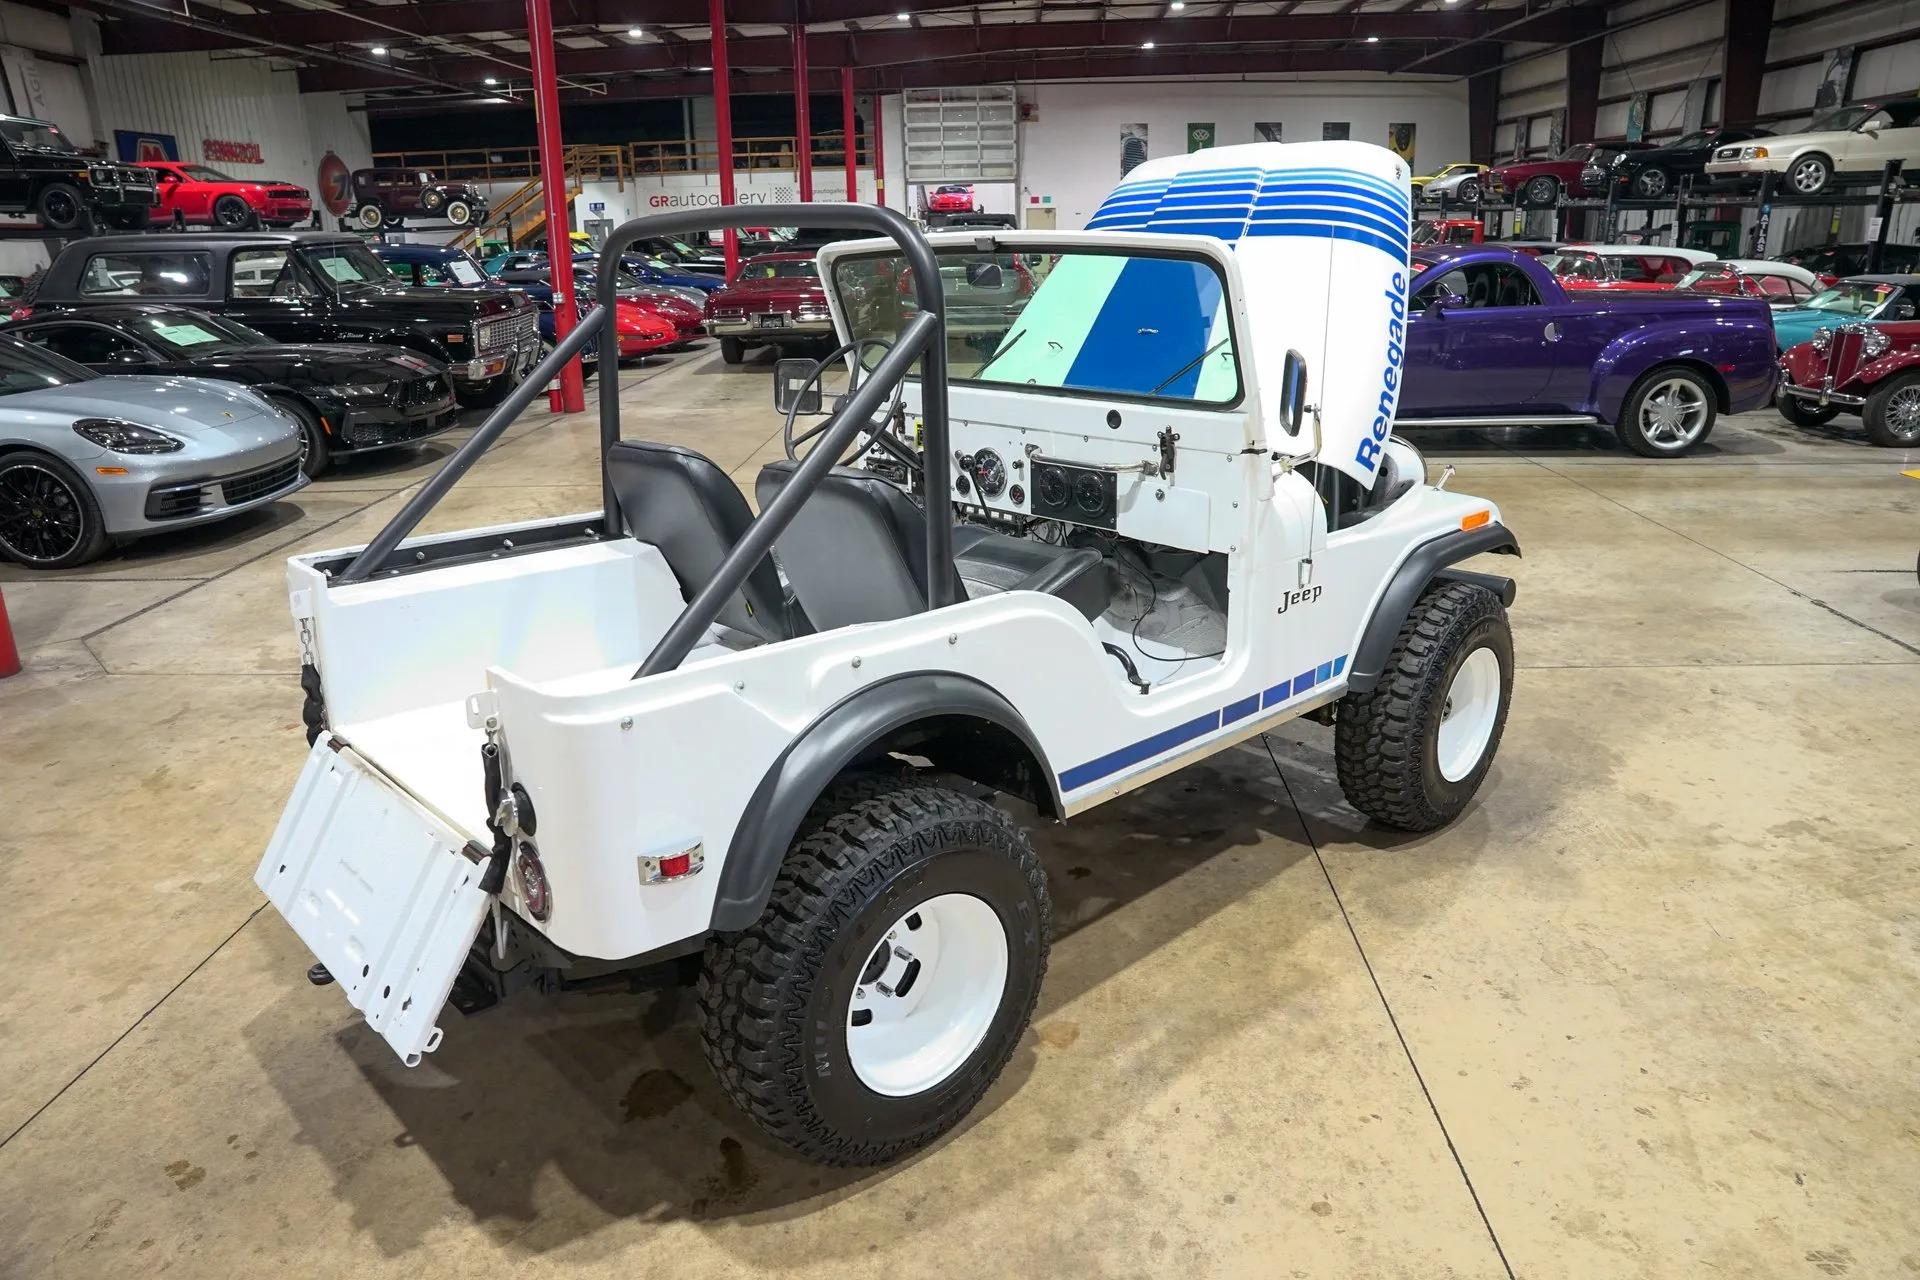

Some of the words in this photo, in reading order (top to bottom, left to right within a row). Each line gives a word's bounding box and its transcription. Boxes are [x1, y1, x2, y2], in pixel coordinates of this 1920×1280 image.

[649, 187, 767, 207] GRautoglery
[1756, 214, 1769, 252] ATLAS
[1355, 271, 1407, 473] Renegade
[1277, 585, 1322, 614] Jeep
